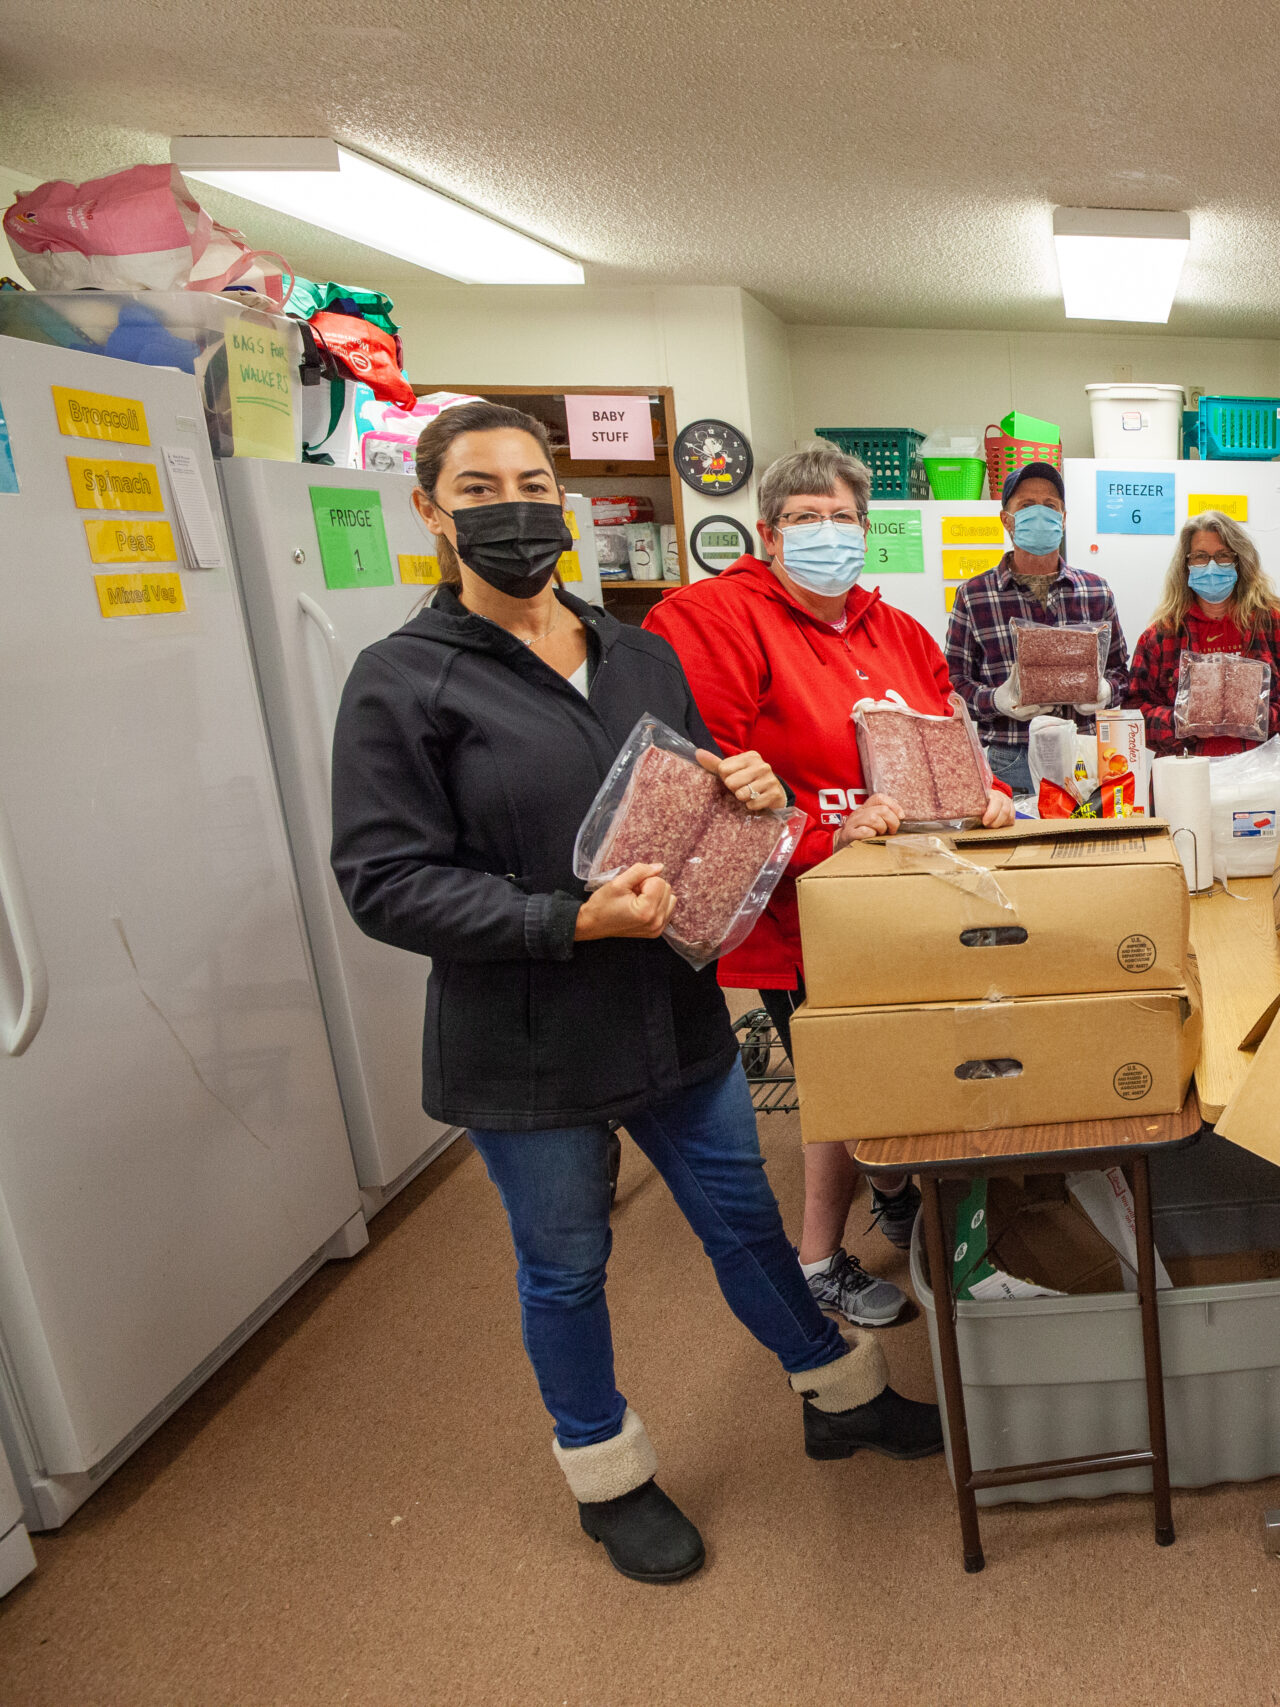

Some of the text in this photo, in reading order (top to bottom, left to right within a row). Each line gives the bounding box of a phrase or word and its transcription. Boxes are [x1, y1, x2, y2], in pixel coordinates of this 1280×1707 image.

[233, 335, 288, 362] BAGS FOR
[239, 364, 288, 394] WALKERS
[68, 399, 140, 431] Broccoli
[592, 411, 625, 422] BABY
[591, 431, 629, 443] STUFF
[83, 468, 151, 497] Spinach
[1108, 483, 1164, 497] FREEZER
[329, 508, 372, 528] FRIDGE
[1131, 509, 1142, 524] 6
[950, 524, 999, 537] Cheese
[115, 531, 156, 551] Peas
[354, 548, 365, 572] 1
[634, 539, 651, 567] 5
[878, 547, 889, 563] 3
[107, 585, 176, 605] Mixed Veg
[1128, 723, 1140, 763] Peaches
